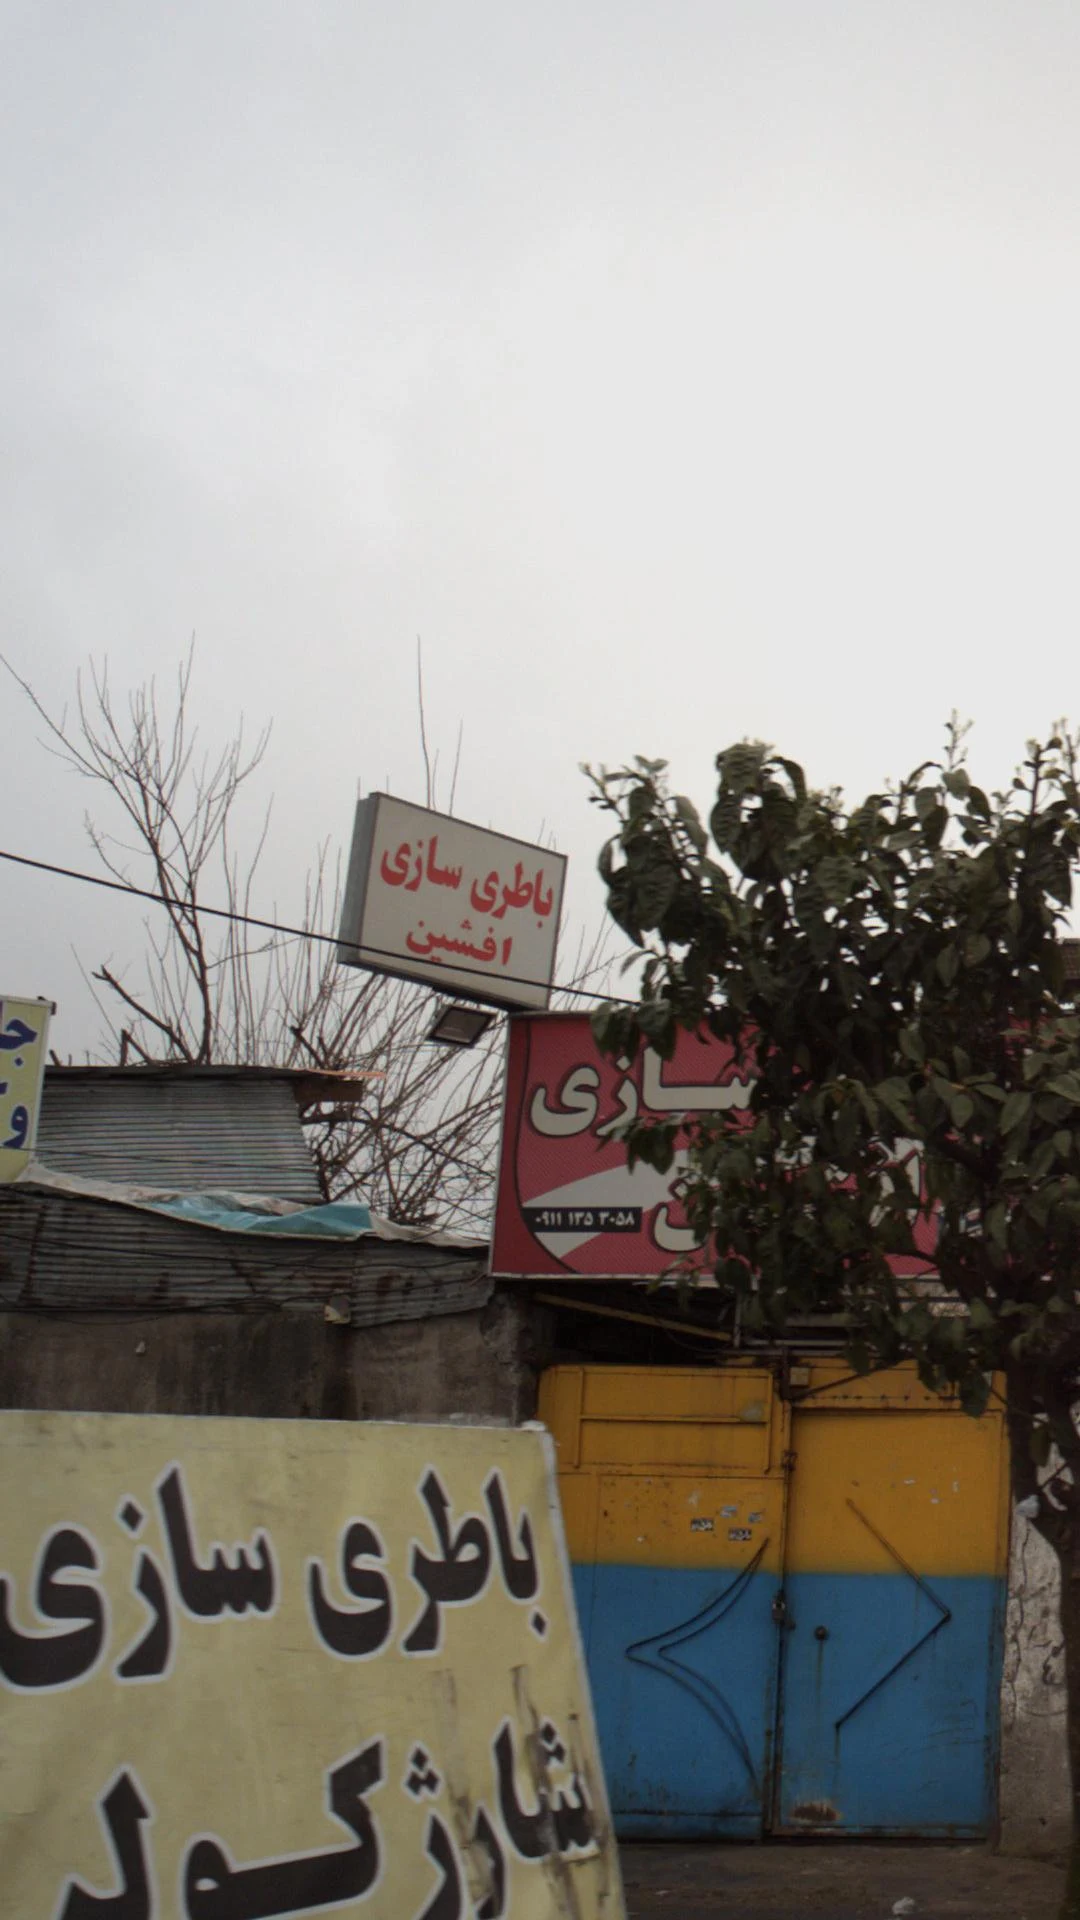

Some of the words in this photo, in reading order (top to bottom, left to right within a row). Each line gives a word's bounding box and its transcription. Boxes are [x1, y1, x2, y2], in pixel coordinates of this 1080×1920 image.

[380, 835, 463, 893] سازی
[470, 861, 554, 929] باطری
[405, 919, 513, 966] افشین
[535, 1210, 562, 1227] ۰۹۱۱
[0, 1466, 275, 1688] سازی
[310, 1470, 547, 1657] باطری
